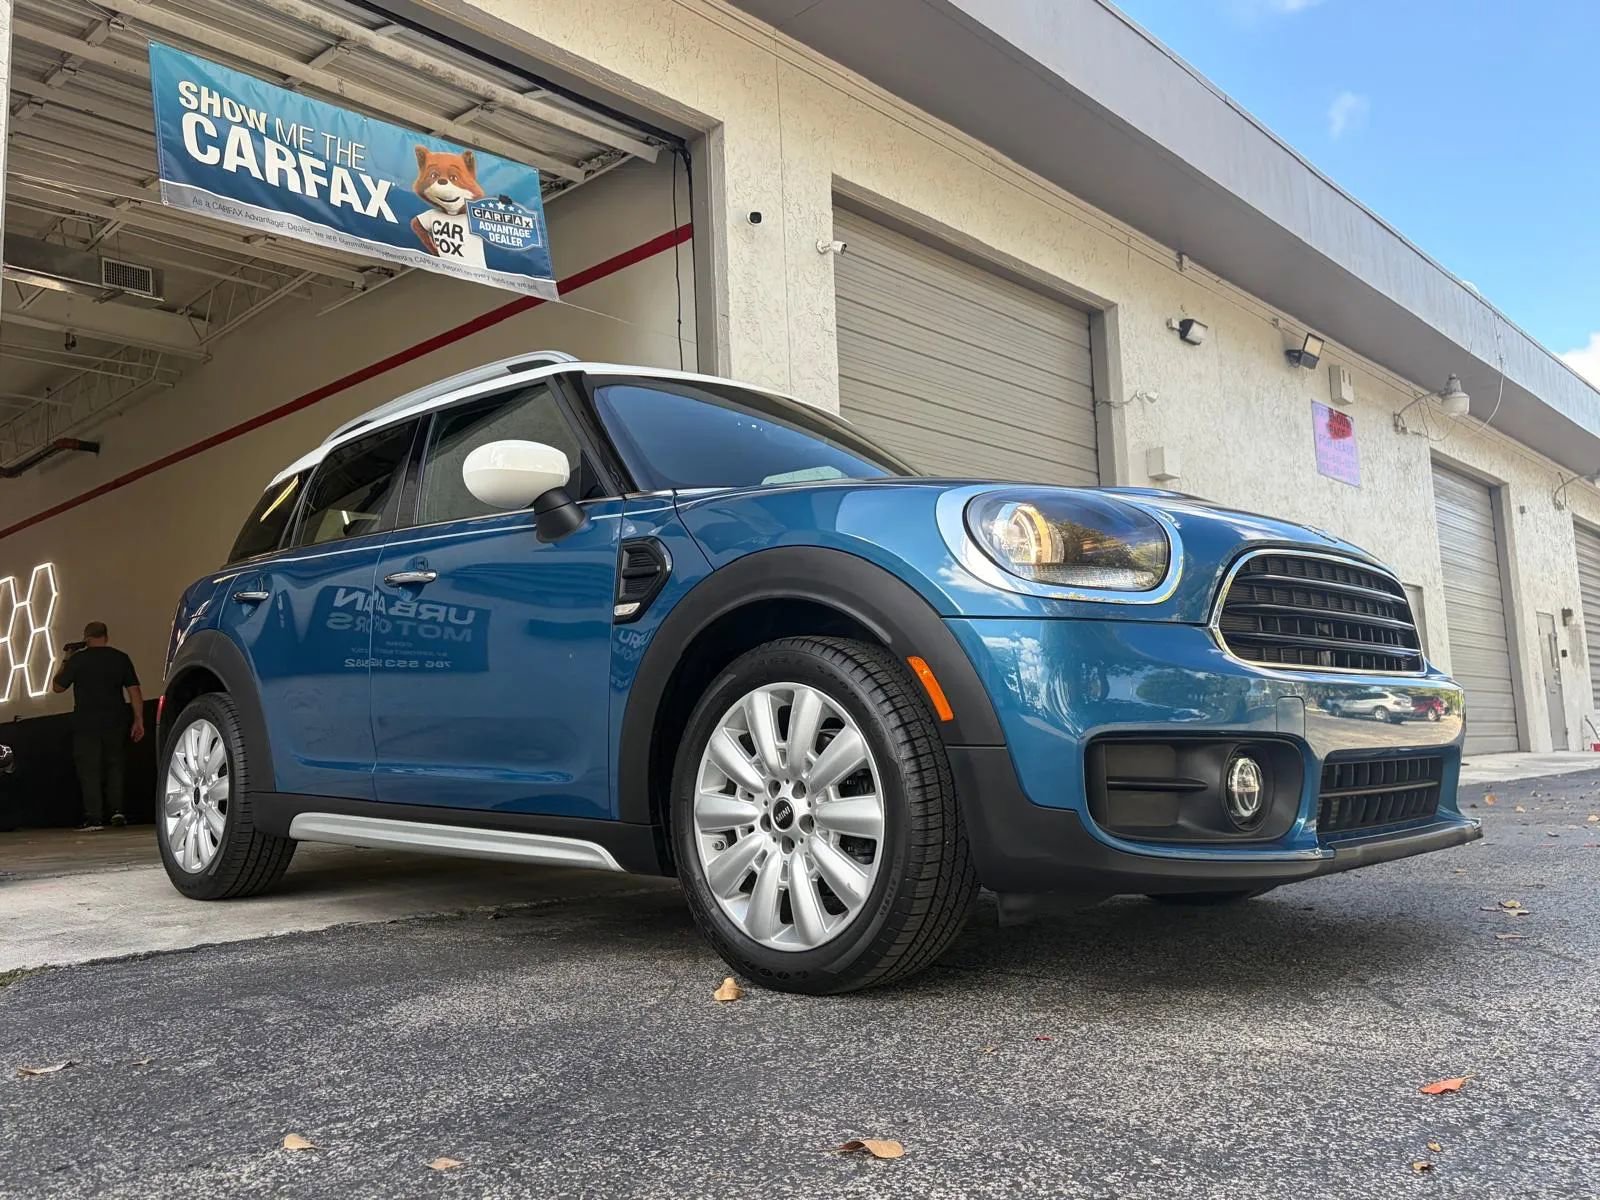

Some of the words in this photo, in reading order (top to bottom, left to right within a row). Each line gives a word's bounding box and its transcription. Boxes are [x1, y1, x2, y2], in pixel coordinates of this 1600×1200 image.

[178, 80, 267, 134] SHOW
[275, 118, 314, 155] ME
[321, 131, 366, 171] THE
[181, 112, 399, 224] CARFAX
[473, 208, 532, 228] CARFAX
[432, 220, 464, 242] CAR
[479, 221, 531, 238] ADVANTAGE
[488, 231, 523, 247] DEALER
[434, 238, 465, 258] FOX
[775, 805, 791, 823] MINI
